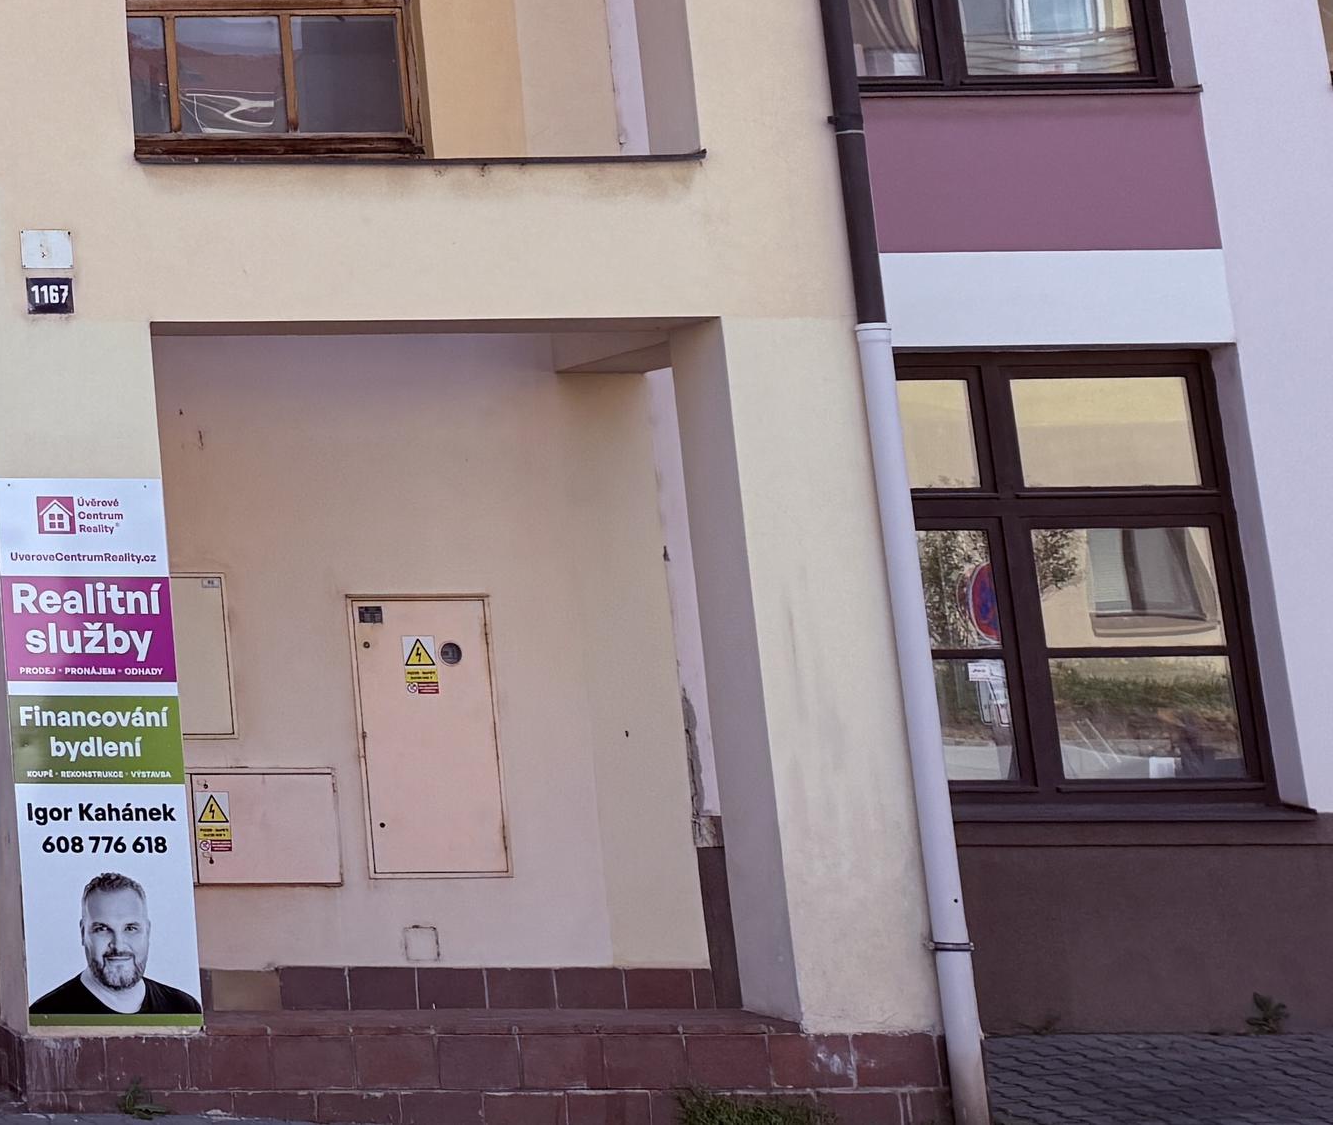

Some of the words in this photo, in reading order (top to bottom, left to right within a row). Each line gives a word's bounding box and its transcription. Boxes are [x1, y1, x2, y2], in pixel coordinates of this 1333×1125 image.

[31, 285, 69, 304] 1167
[77, 497, 119, 507] Úvěrové
[78, 512, 124, 520] Centrum
[10, 552, 157, 564] UveroveCentrumReality.cz
[11, 583, 162, 615] Realitní
[25, 622, 153, 662] služby
[19, 667, 56, 675] PRODEJ
[64, 666, 116, 675] PRONÁJEM
[124, 667, 163, 675] ODHADY
[19, 706, 169, 727] Financování
[49, 736, 142, 762] bydlení
[27, 770, 54, 778] KOUPĚ
[60, 770, 124, 778] REKONSTRUKCE
[130, 769, 172, 778] VÝSTAVBA
[26, 802, 73, 826] Igor
[78, 802, 176, 822] Kahánek
[41, 836, 84, 854] 608
[88, 836, 127, 854] 776
[132, 836, 168, 854] 618
